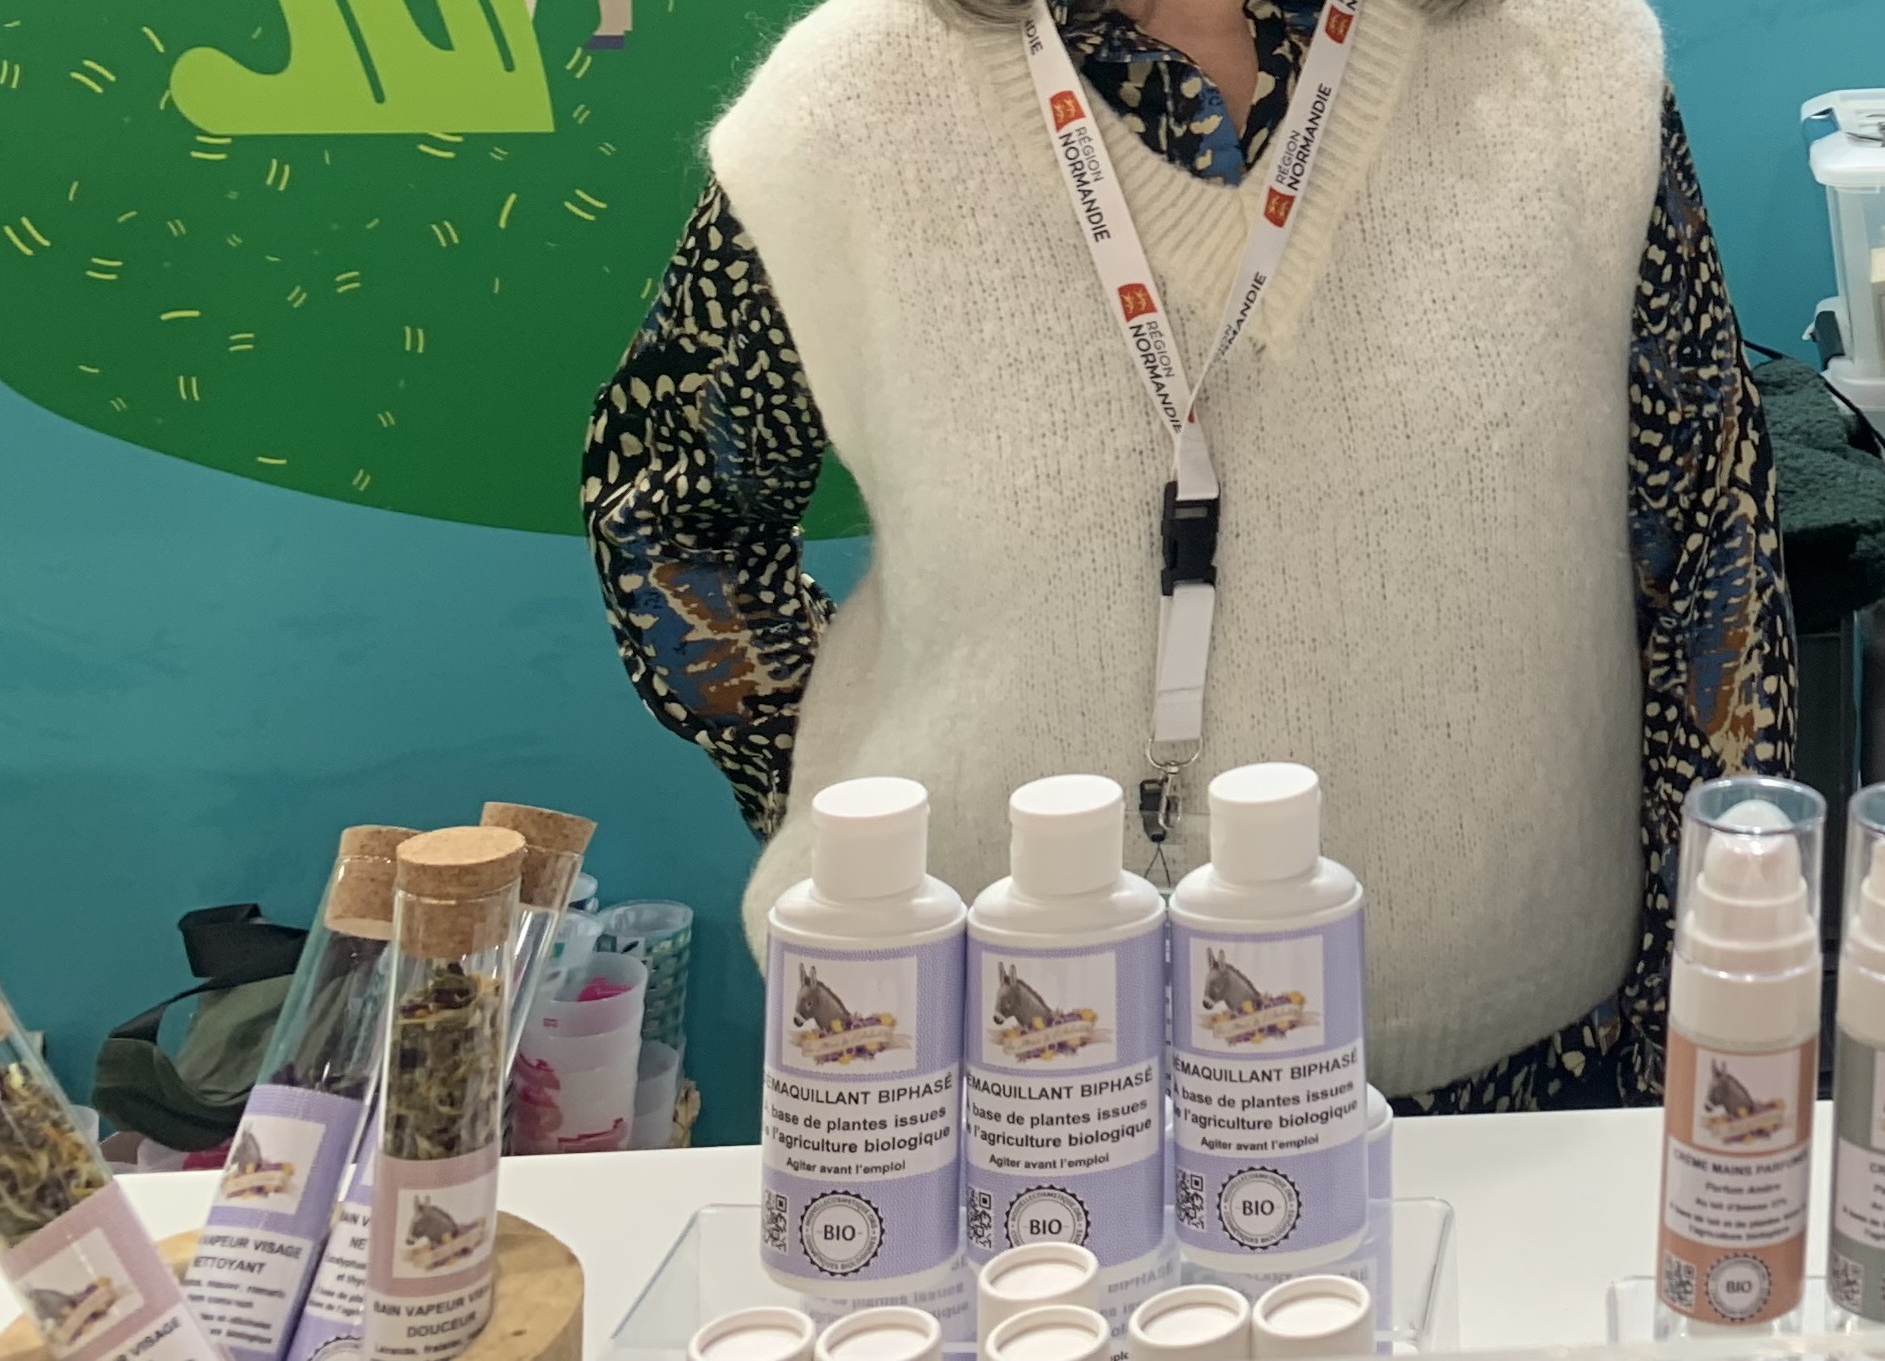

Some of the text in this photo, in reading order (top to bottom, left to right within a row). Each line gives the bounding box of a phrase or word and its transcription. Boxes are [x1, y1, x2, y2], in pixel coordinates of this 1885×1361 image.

[1288, 83, 1332, 193] NORMANDIE
[1075, 126, 1104, 183] RÉGION
[1276, 129, 1301, 187] RÉGION
[1058, 132, 1112, 244] NORMANDIE
[1146, 320, 1175, 378] RÉGION
[1129, 324, 1183, 435] NORMANDIE
[1290, 1047, 1358, 1080] BIPHASÉ
[878, 1072, 952, 1103] BIPHASÉ
[1081, 1065, 1153, 1098] BIPHASÉ
[1182, 1081, 1354, 1111] base de plantes issues
[771, 1104, 946, 1133] base de plantes issues
[972, 1099, 1147, 1129] base de plantes issues
[1184, 1100, 1358, 1130] l'agriculture biologique
[773, 1126, 950, 1153] l'agriculture biologique
[973, 1118, 1152, 1148] l'agriculture biologique
[1201, 1133, 1319, 1151] Agiter avant l'emploi
[786, 1157, 906, 1175] Agiter avant l'emploi
[989, 1152, 1110, 1169] Agiter avant l'emploi
[1242, 1199, 1275, 1216] BIO
[824, 1224, 856, 1241] BIO
[1029, 1219, 1062, 1235] BIO
[253, 1241, 303, 1259] VISAGE
[1726, 1280, 1753, 1295] BIO
[373, 1294, 464, 1318] BAIN VAPEUR
[407, 1311, 476, 1338] DOUCEUR
